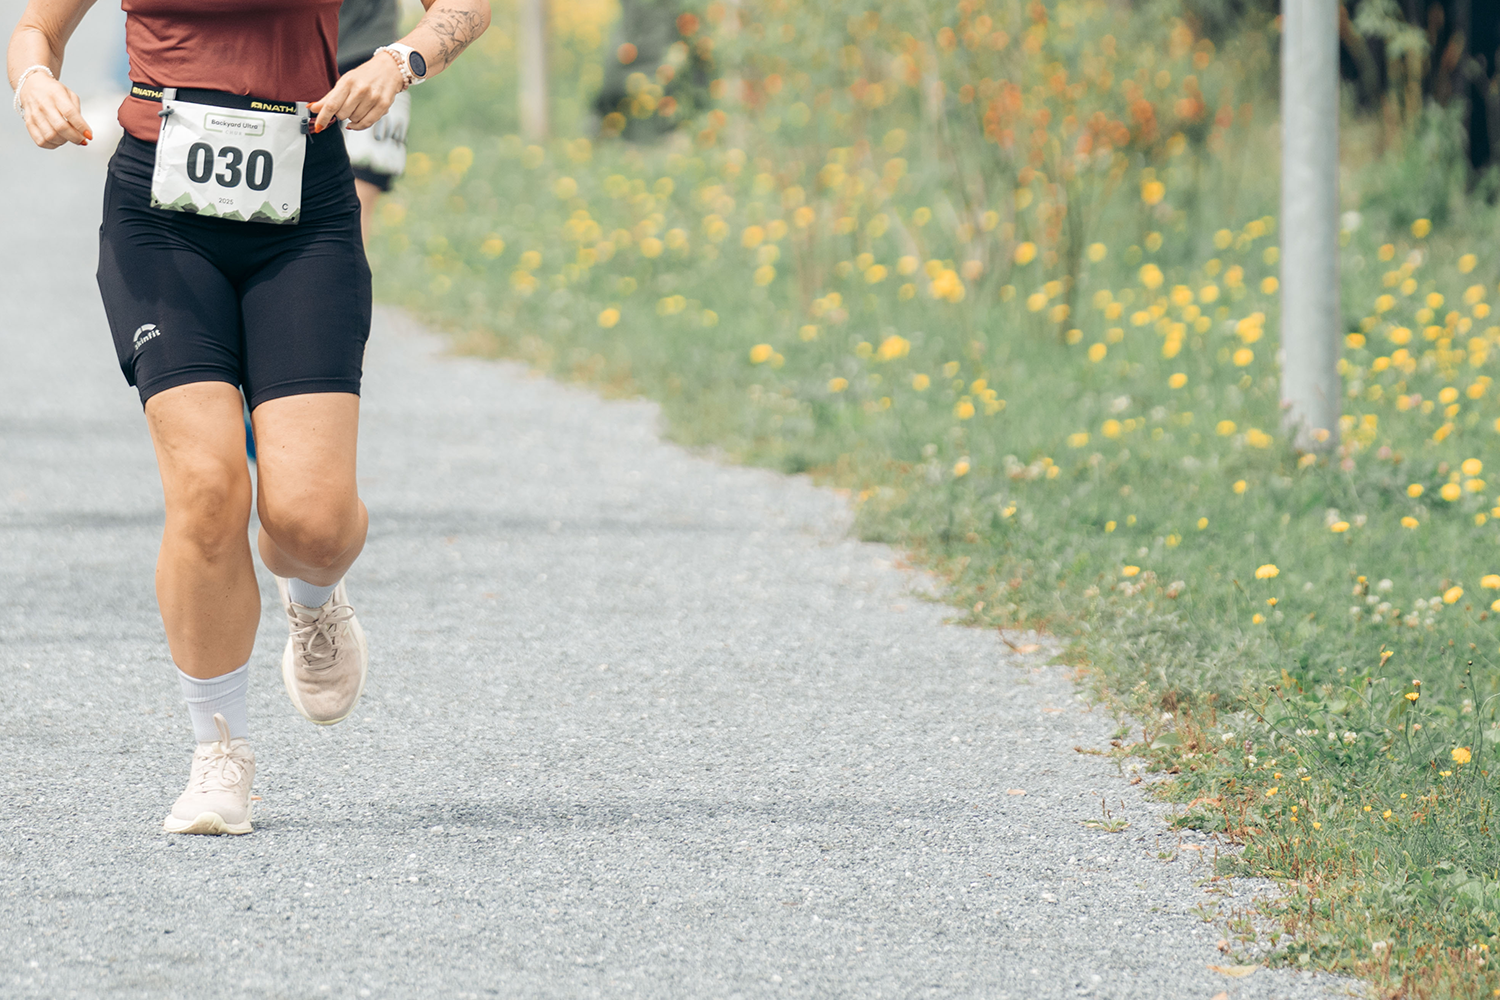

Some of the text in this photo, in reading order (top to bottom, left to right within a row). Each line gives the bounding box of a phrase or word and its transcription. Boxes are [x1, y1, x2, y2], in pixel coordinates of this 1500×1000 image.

[262, 103, 297, 113] NATH
[211, 119, 241, 128] Backyard
[186, 142, 274, 191] 030
[218, 197, 234, 205] 2025
[134, 329, 161, 350] skinfit
